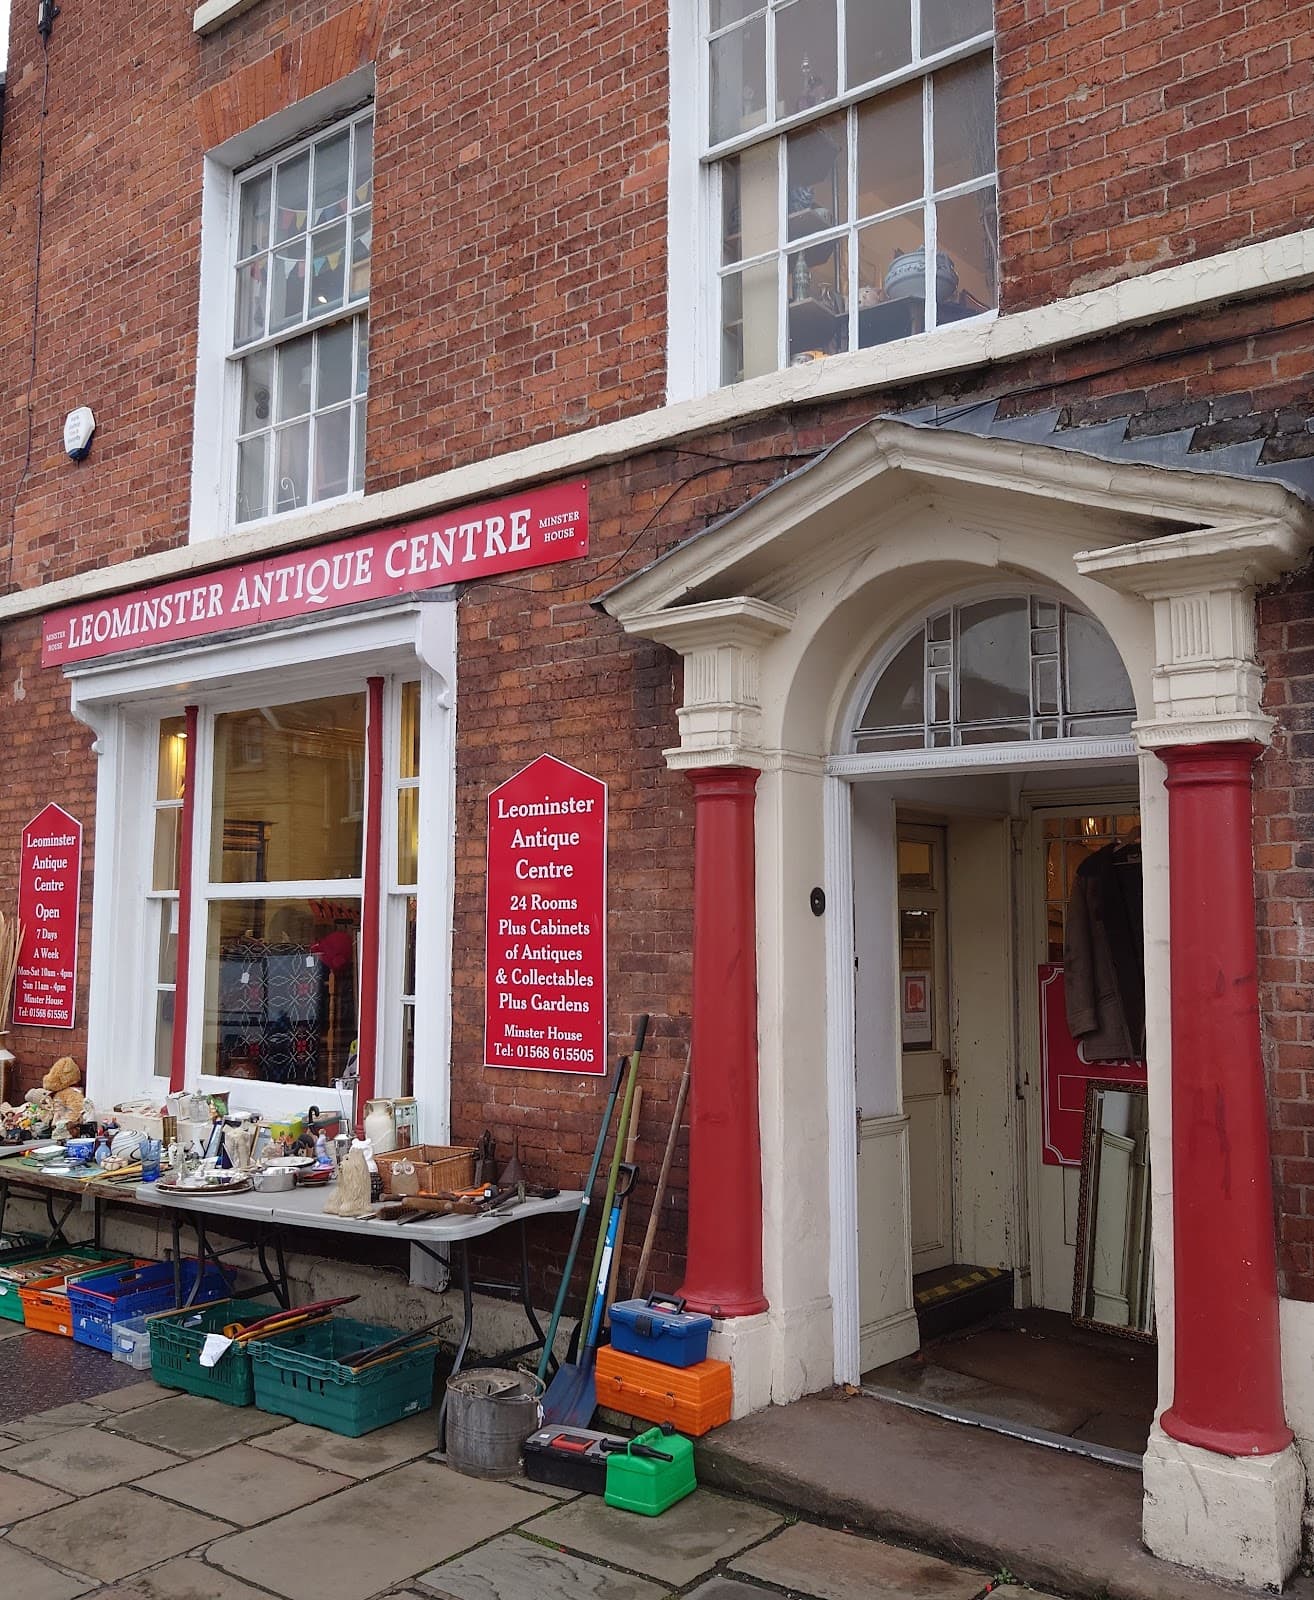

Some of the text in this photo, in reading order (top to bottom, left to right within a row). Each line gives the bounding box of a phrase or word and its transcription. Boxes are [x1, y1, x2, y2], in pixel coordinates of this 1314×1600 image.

[538, 511, 580, 529] MINSTER
[543, 527, 575, 543] HOUSE
[67, 508, 532, 649] LEOMINSTER ANTIQUE CENTRE
[46, 631, 66, 642] MINSTER
[48, 642, 63, 652] HOUSE
[497, 796, 595, 819] Leominster
[27, 832, 76, 848] Leominster
[510, 827, 580, 851] Antique
[32, 854, 68, 872] Antique
[515, 859, 574, 879] Centre
[34, 876, 65, 892] Centre
[510, 894, 578, 911] 24 Rooms
[35, 903, 60, 921] Open
[36, 928, 58, 941] 7 Days
[498, 918, 591, 936] Plus Cabinets
[33, 947, 59, 959] A Week
[505, 944, 583, 964] of Antiques
[17, 965, 40, 976] Mon-Sat
[41, 967, 56, 977] 10am
[60, 969, 73, 979] 4pm
[495, 967, 594, 987] & Collectables
[22, 980, 33, 990] Sun
[34, 981, 49, 991] 11am
[53, 982, 67, 993] 4pm
[24, 993, 64, 1006] Minster House
[499, 992, 590, 1013] Plus Gardens
[18, 1006, 68, 1020] Tel: 01568 615505
[504, 1023, 583, 1041] Minster House
[494, 1042, 594, 1062] Tel: 01568 615505
